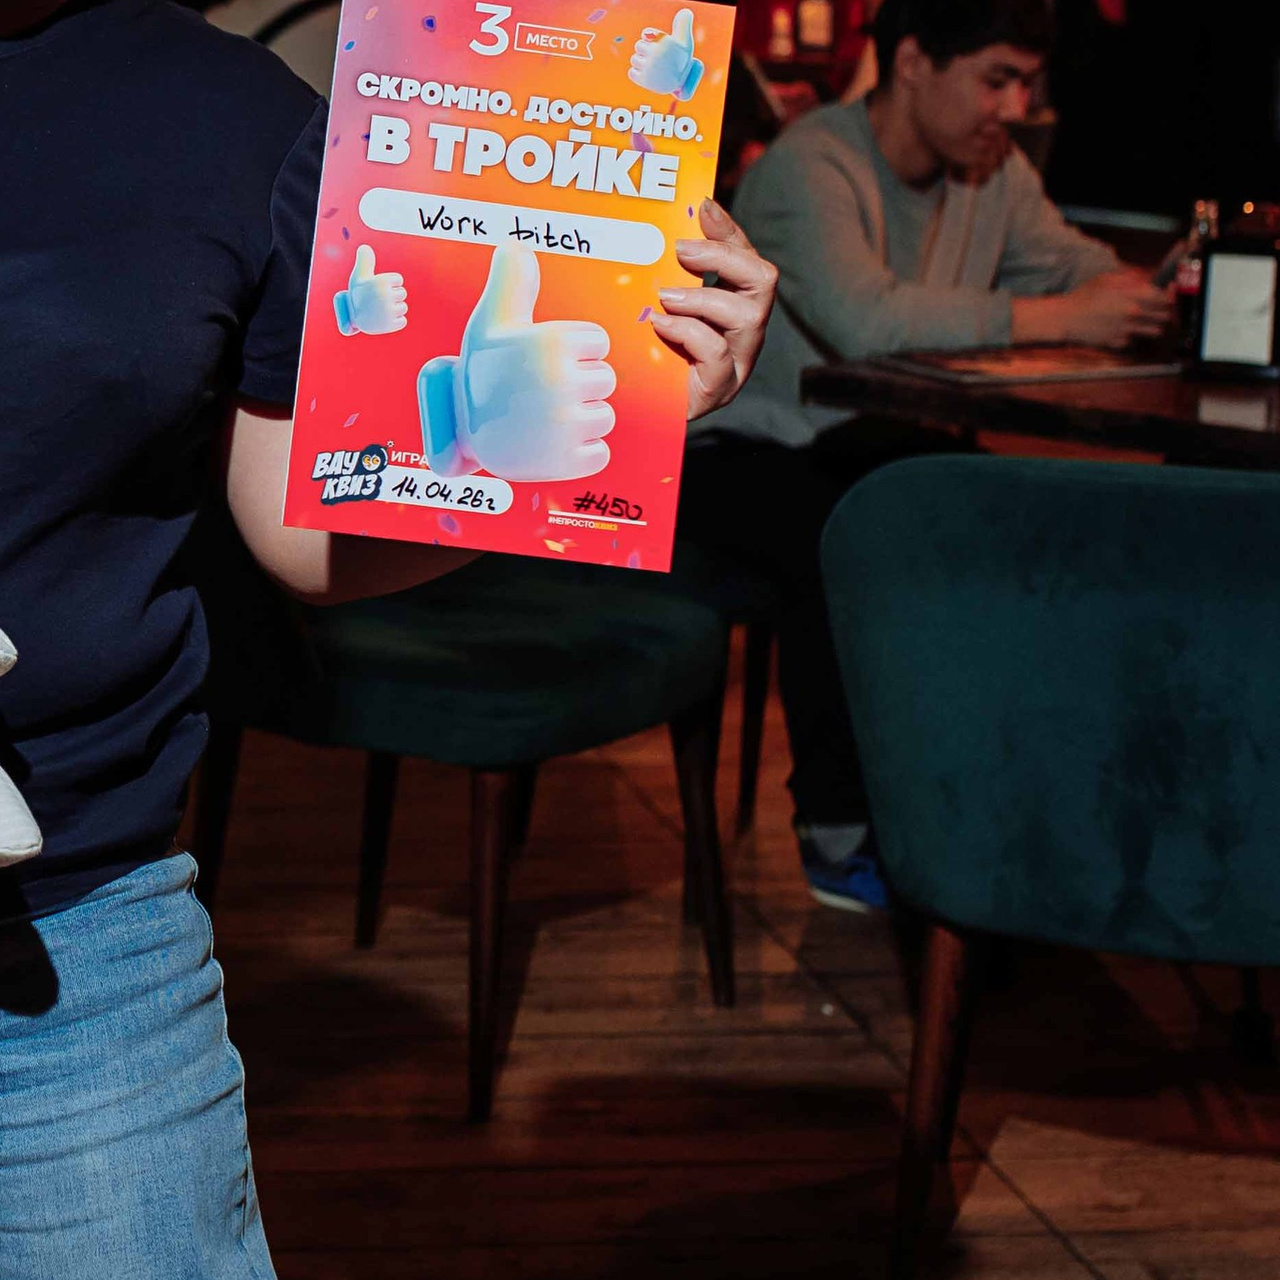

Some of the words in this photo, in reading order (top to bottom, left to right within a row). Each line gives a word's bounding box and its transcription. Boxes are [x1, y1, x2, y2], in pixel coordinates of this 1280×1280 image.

[468, 1, 512, 56] 3
[525, 32, 579, 52] МЕСТО
[356, 72, 518, 117] СКРОМНО.
[524, 95, 704, 143] ДОСТОЙНО.
[366, 114, 411, 166] В
[428, 121, 681, 203] ТРОЙКЕ
[418, 205, 488, 236] Work
[508, 215, 591, 254] bitch
[311, 450, 360, 480] ВАУ
[391, 450, 430, 466] ИГРА
[321, 473, 378, 501] КВИЗ
[572, 490, 644, 521] #450
